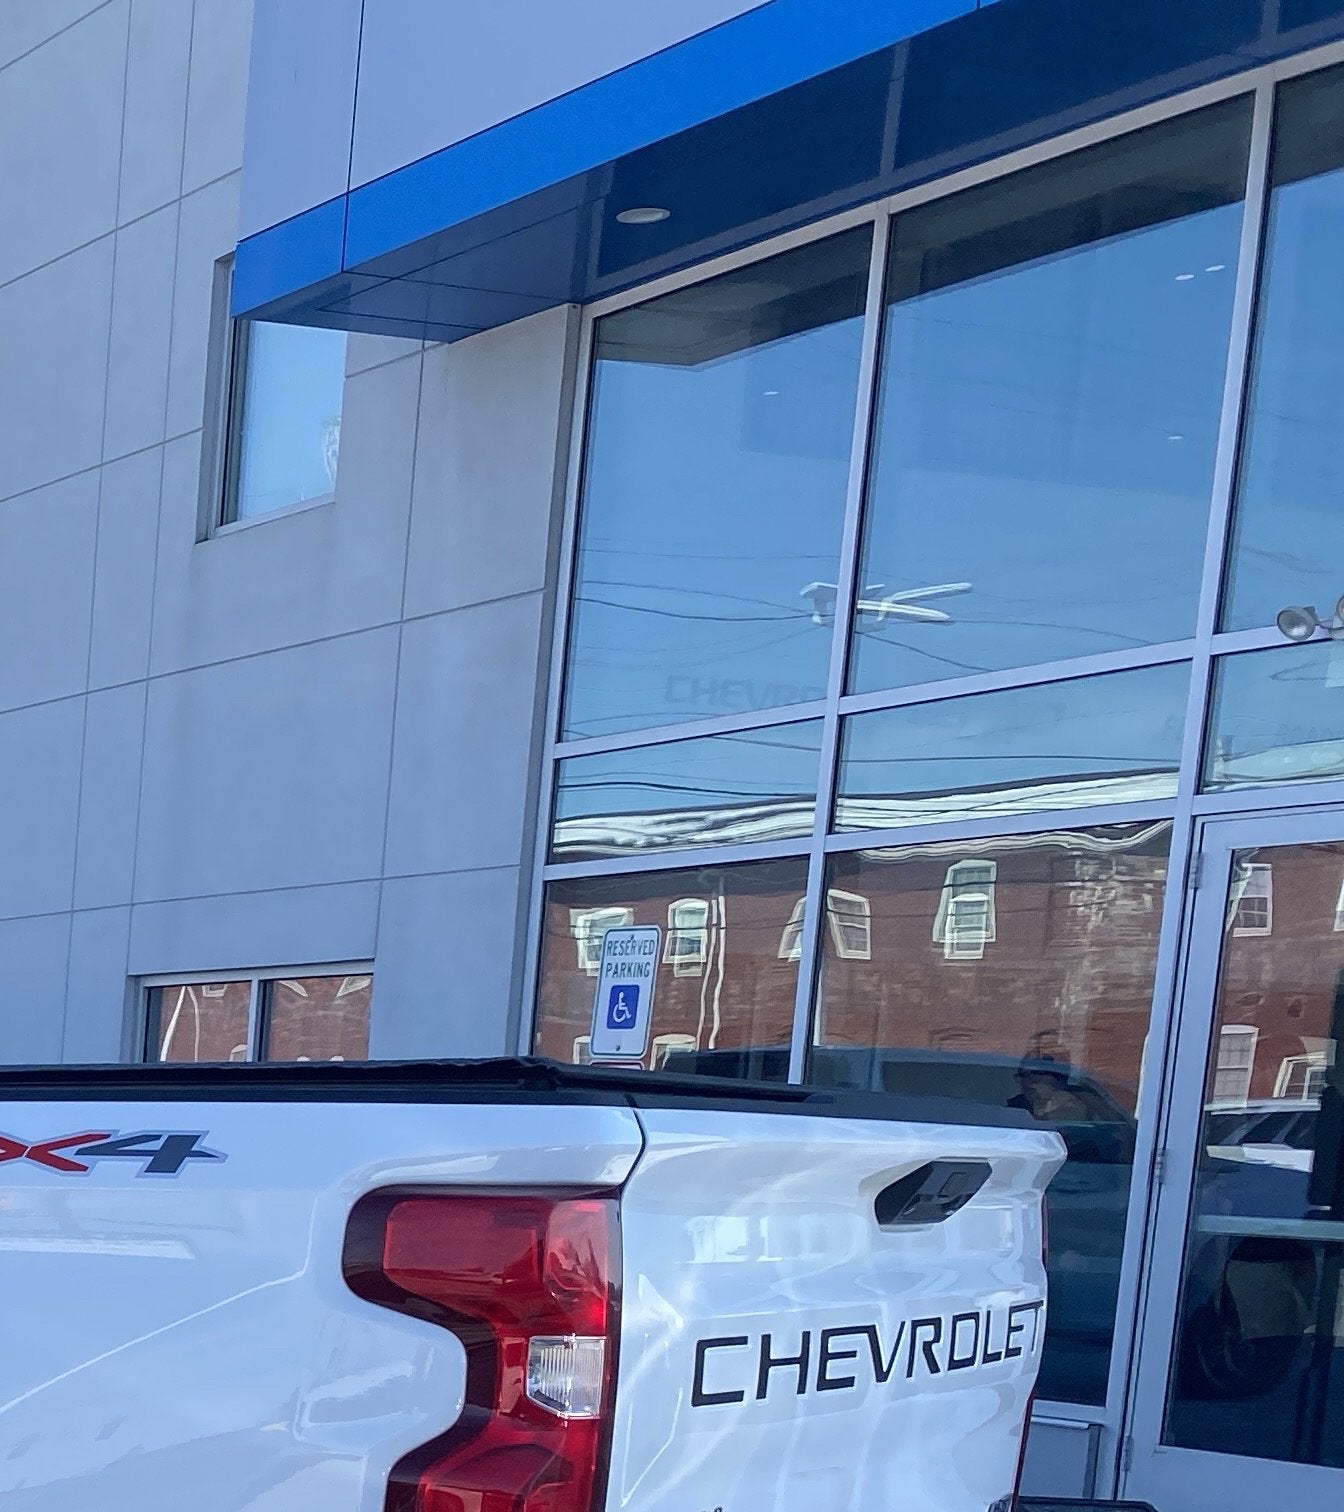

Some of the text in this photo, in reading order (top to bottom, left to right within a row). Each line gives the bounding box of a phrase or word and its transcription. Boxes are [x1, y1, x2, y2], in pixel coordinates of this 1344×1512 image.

[606, 938, 656, 956] RESERVED
[605, 961, 651, 979] PARKING
[691, 1299, 1046, 1408] CHEVROLET
